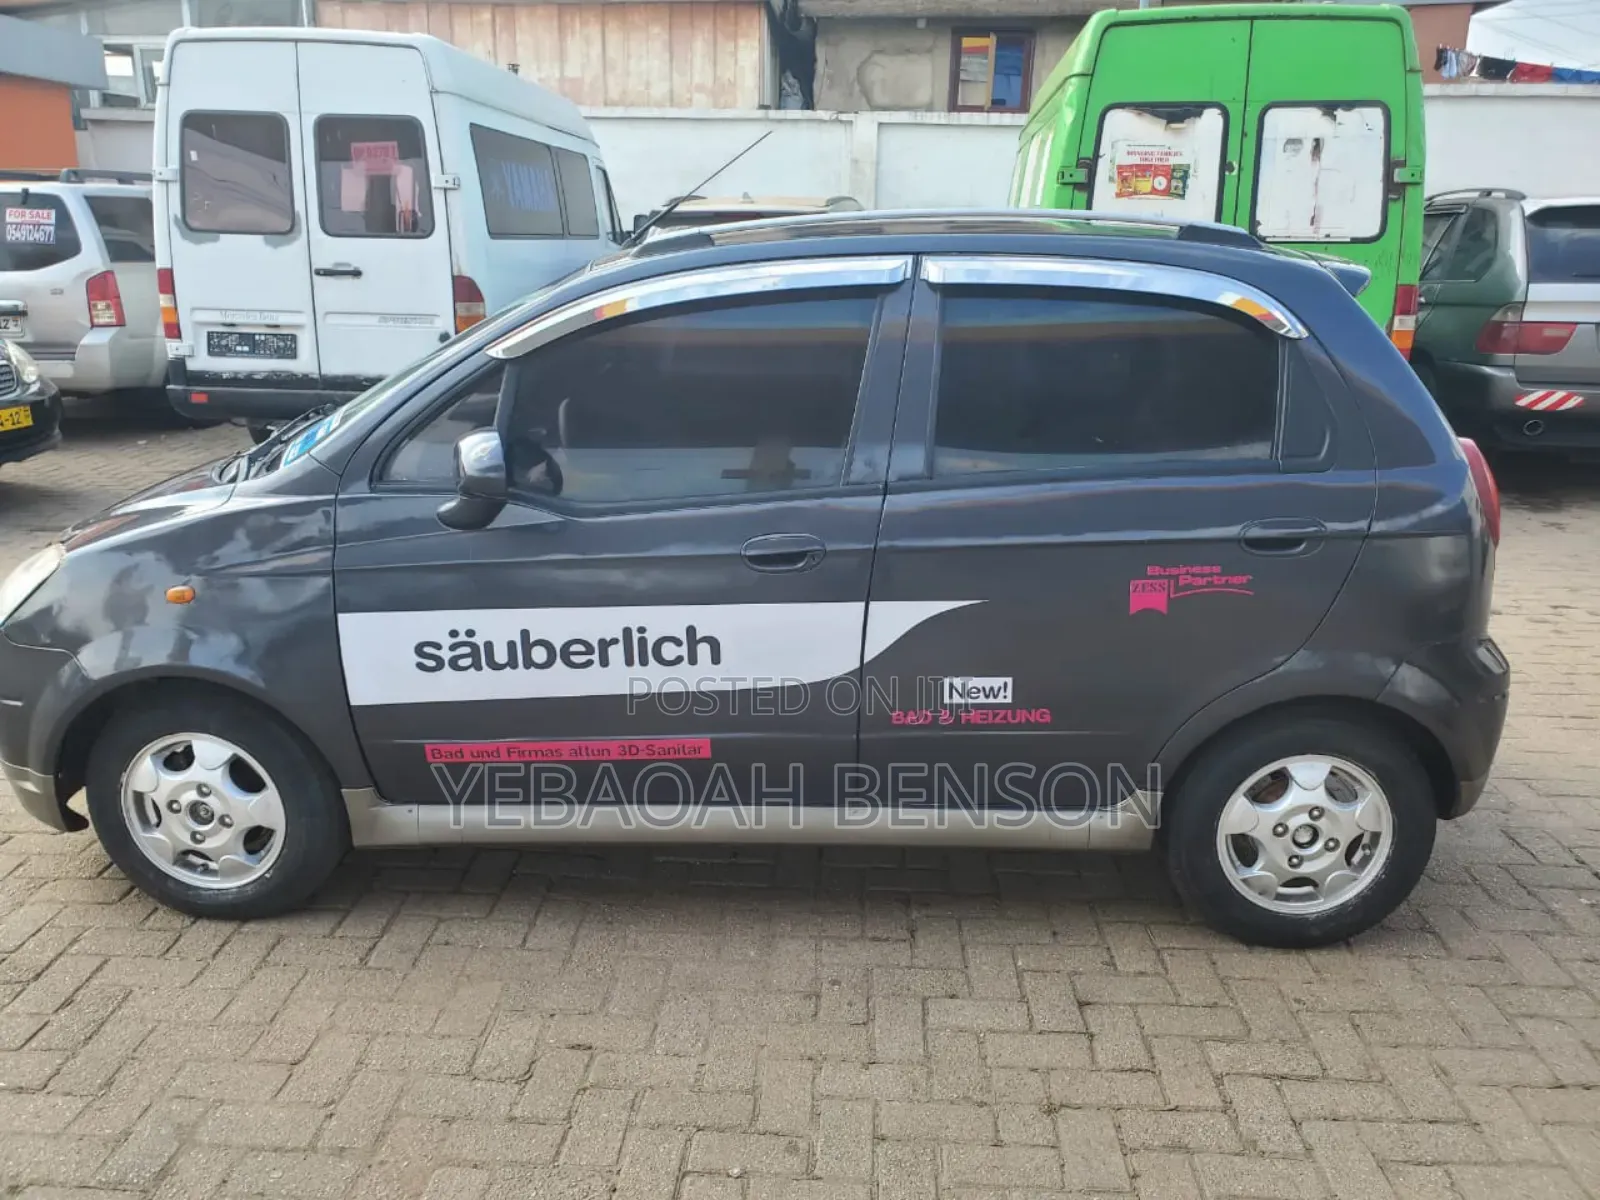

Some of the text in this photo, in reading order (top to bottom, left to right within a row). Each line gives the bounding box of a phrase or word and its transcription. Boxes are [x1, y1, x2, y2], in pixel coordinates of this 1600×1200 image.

[8, 209, 52, 220] FOR SALE
[1147, 565, 1222, 575] Business
[1178, 574, 1254, 586] Partner
[413, 624, 722, 673] säuberlich
[948, 681, 1009, 700] New!
[891, 710, 932, 725] BAD
[960, 708, 1052, 725] HEIZUNG
[430, 748, 465, 760] Bad
[469, 746, 501, 759] und
[506, 746, 563, 758] Firmas
